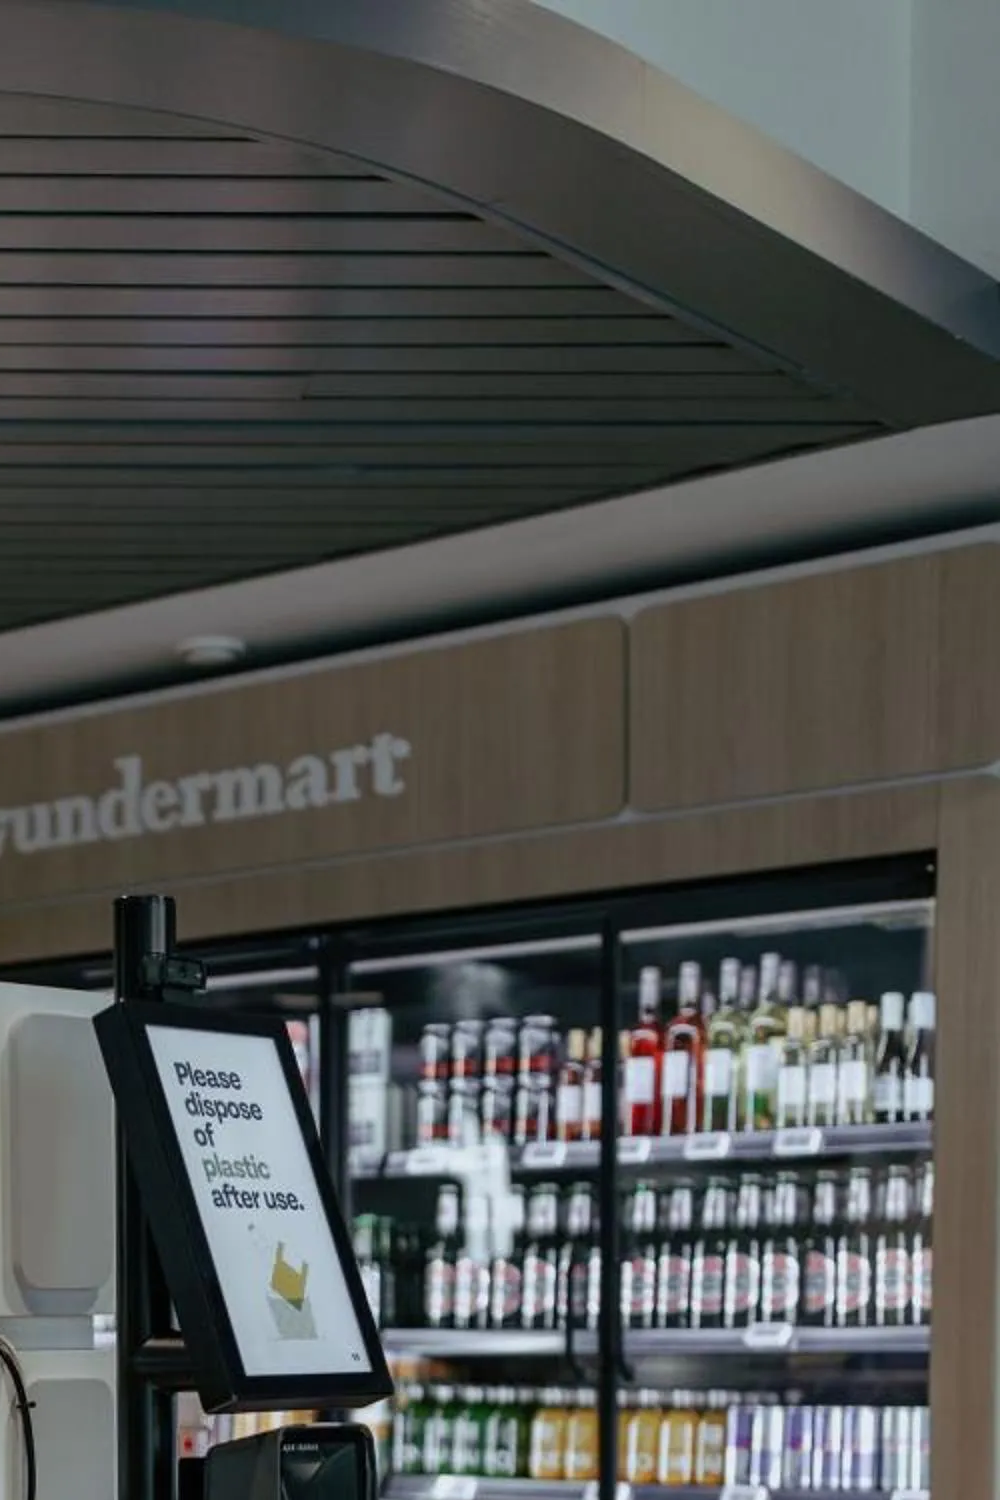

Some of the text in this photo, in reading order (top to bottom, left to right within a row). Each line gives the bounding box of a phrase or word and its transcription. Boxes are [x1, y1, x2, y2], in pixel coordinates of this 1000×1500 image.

[173, 1061, 242, 1090] Please
[185, 1092, 263, 1124] dispose
[193, 1122, 215, 1147] of
[202, 1152, 271, 1182] plastic
[211, 1184, 305, 1211] after use.
